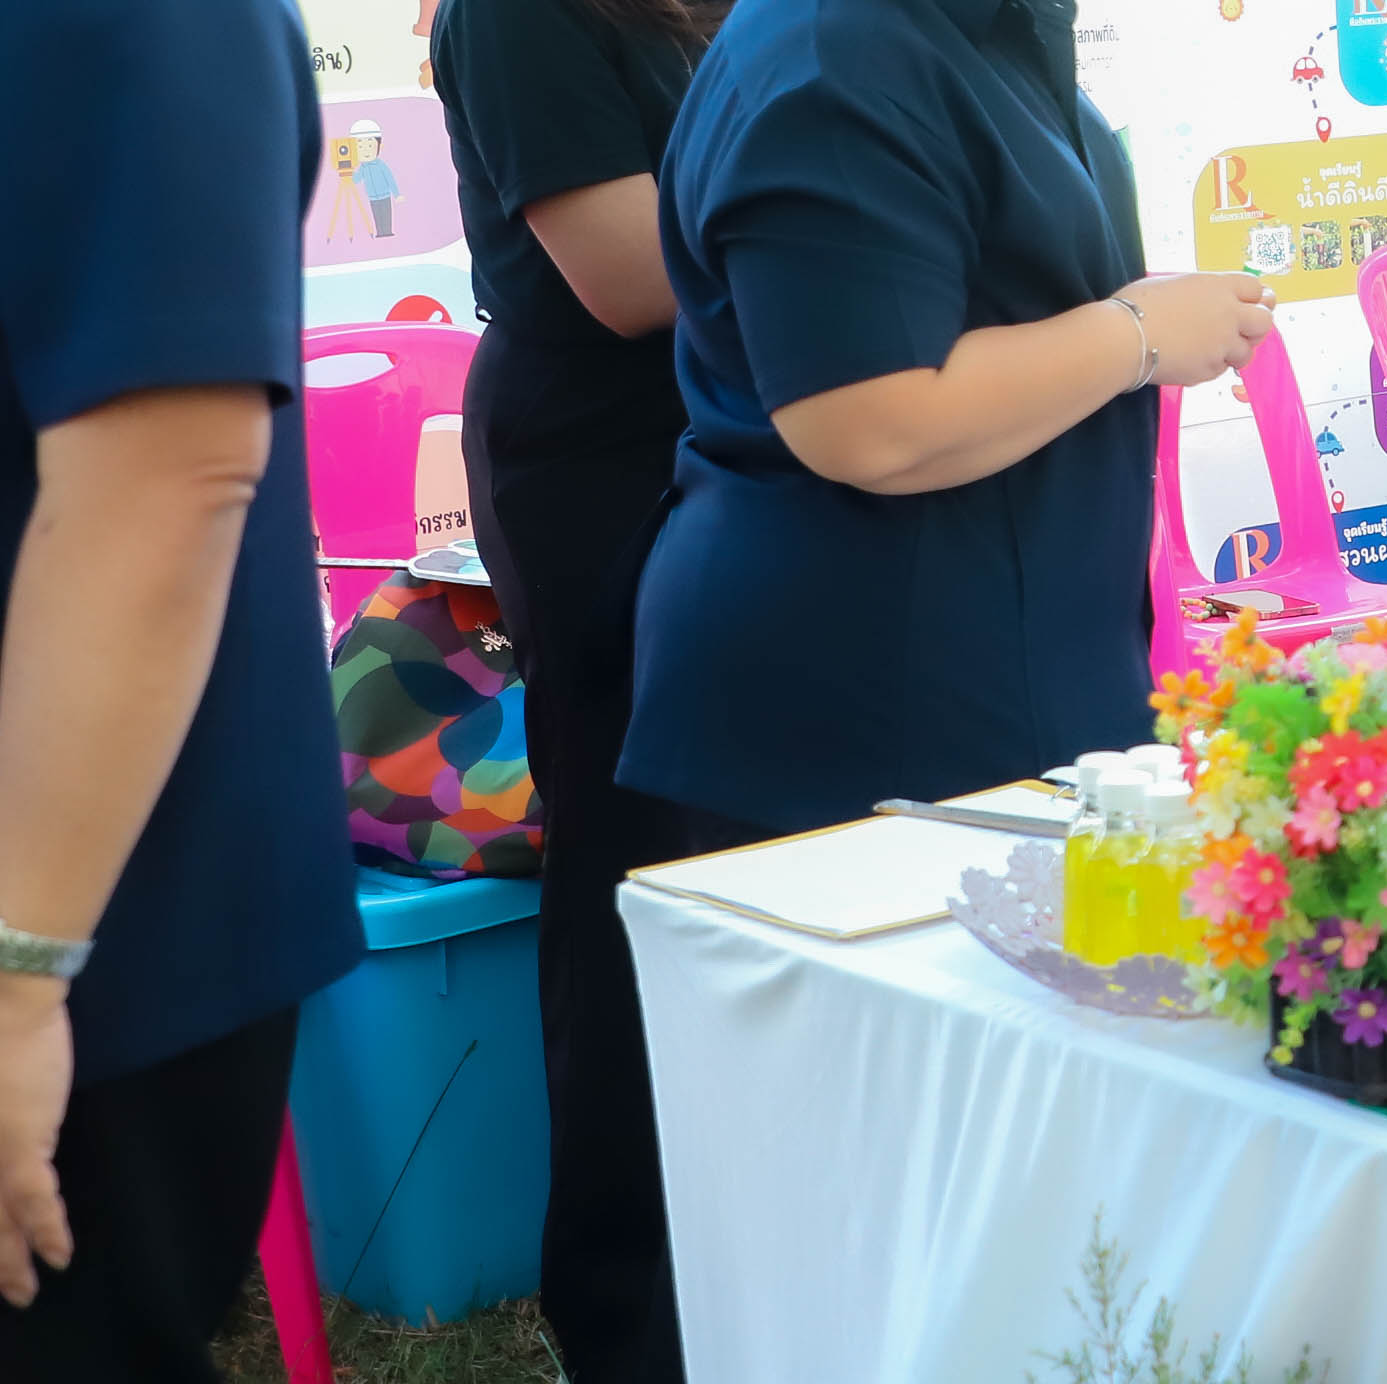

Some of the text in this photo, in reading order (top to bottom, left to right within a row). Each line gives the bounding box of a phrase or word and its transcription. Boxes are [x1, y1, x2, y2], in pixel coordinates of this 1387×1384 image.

[1343, 517, 1387, 542] จุดเรียนรู้
